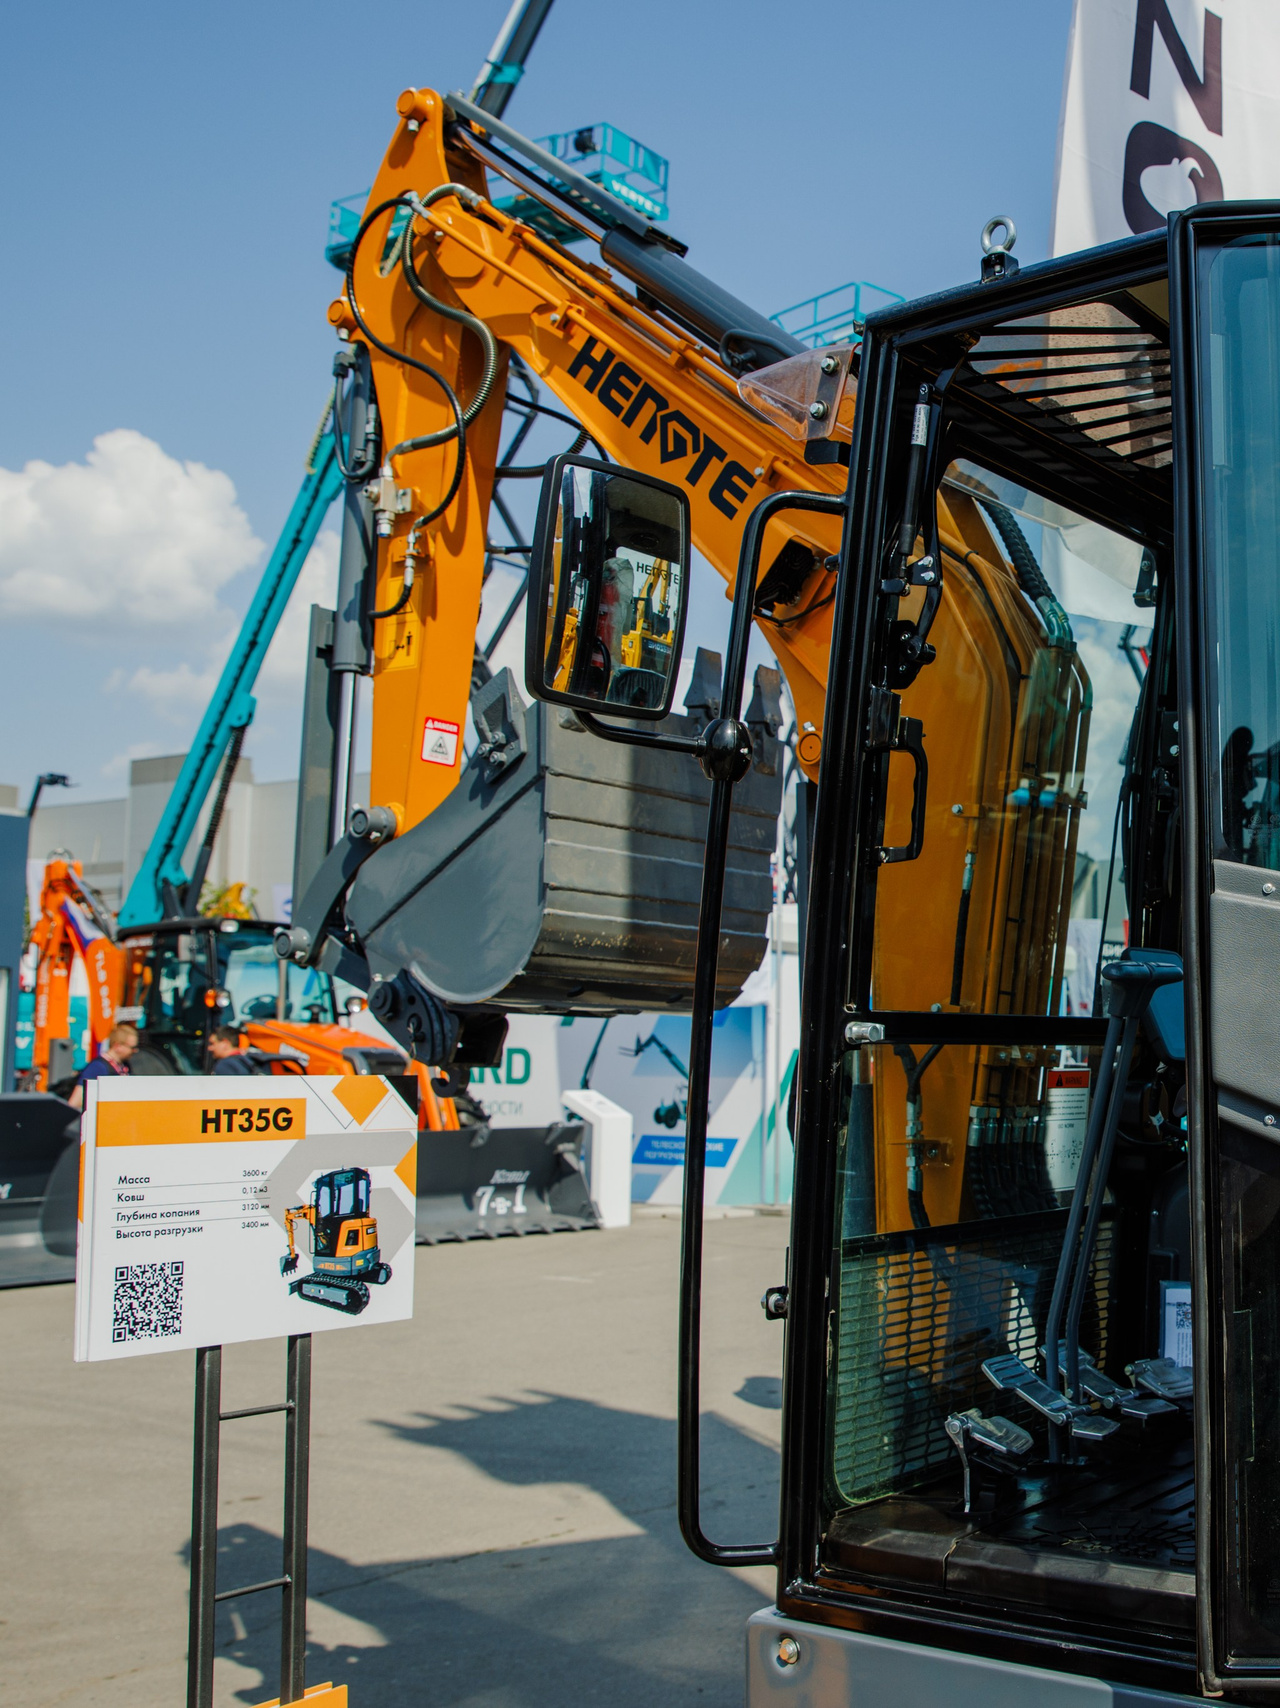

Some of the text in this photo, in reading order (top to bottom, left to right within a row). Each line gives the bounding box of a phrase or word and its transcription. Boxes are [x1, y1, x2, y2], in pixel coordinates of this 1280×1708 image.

[201, 1107, 293, 1133] HT35G
[118, 1176, 150, 1185] Масса
[117, 1193, 145, 1202] Ковш
[242, 1187, 257, 1195] 0,12
[116, 1211, 158, 1222] Глубина
[159, 1209, 200, 1219] копания
[242, 1203, 259, 1211] 3120
[116, 1229, 151, 1239] Высота
[154, 1225, 203, 1238] разгрузки
[241, 1221, 259, 1229] 3400
